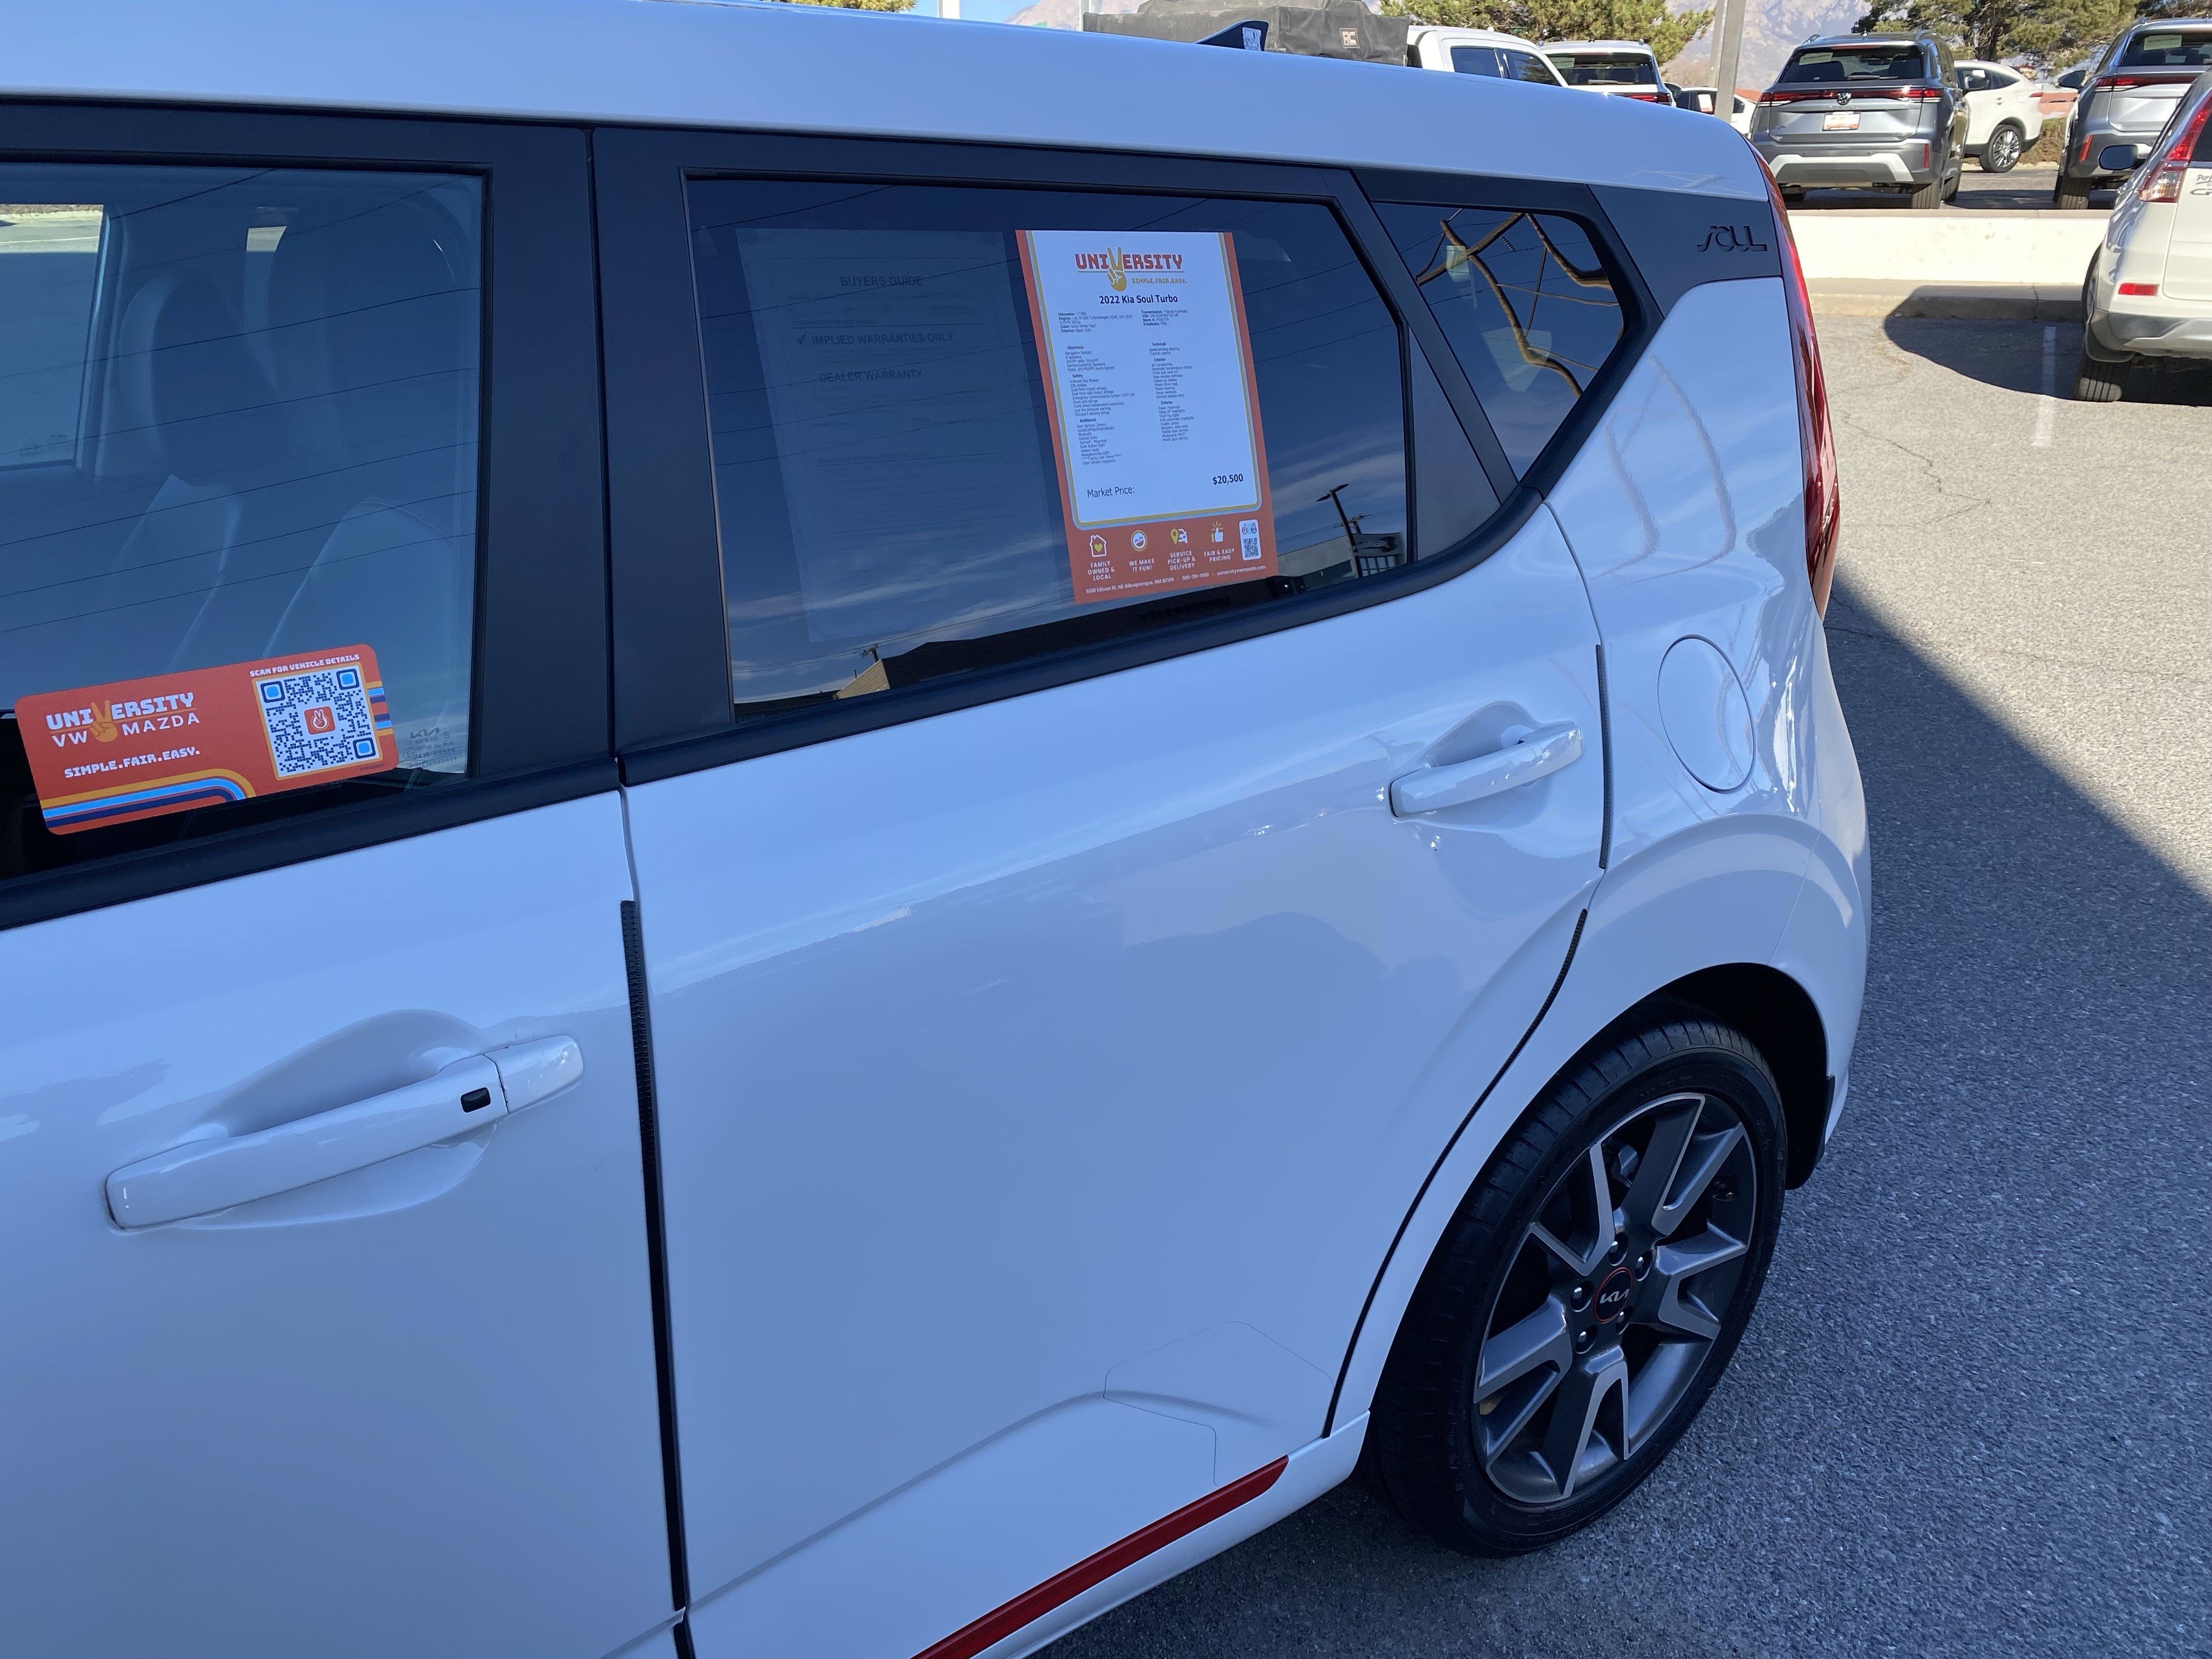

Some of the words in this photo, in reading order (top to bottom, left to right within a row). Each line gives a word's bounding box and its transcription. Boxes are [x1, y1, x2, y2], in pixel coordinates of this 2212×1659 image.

[1697, 226, 1768, 252] SOUL
[1076, 253, 1182, 269] UNIVERSITY
[840, 275, 886, 287] BUYERS
[889, 275, 923, 286] GUIDE
[1099, 296, 1120, 304] 2022
[1121, 295, 1135, 303] Kia
[1136, 295, 1153, 303] Soul
[1155, 294, 1178, 302] Turbo
[812, 334, 854, 346] IMPLIED
[857, 333, 926, 345] WARRANTIES
[927, 332, 953, 342] ONLY
[819, 370, 862, 383] DEALER
[864, 369, 923, 381] WARRANTY
[1212, 473, 1243, 485] $20,500
[1087, 488, 1113, 498] Market
[1115, 487, 1135, 495] Price:
[250, 668, 271, 677] SCAN
[273, 665, 289, 674] FOR
[289, 659, 325, 671] VEHICLE
[326, 654, 360, 664] DETAILS
[45, 692, 194, 731] UNIVERSITY
[52, 730, 88, 747] VW
[122, 713, 200, 736] MAZDA
[64, 746, 201, 778] SIMPLE.FAIR.EASY.
[1599, 1288, 1630, 1304] KIA
